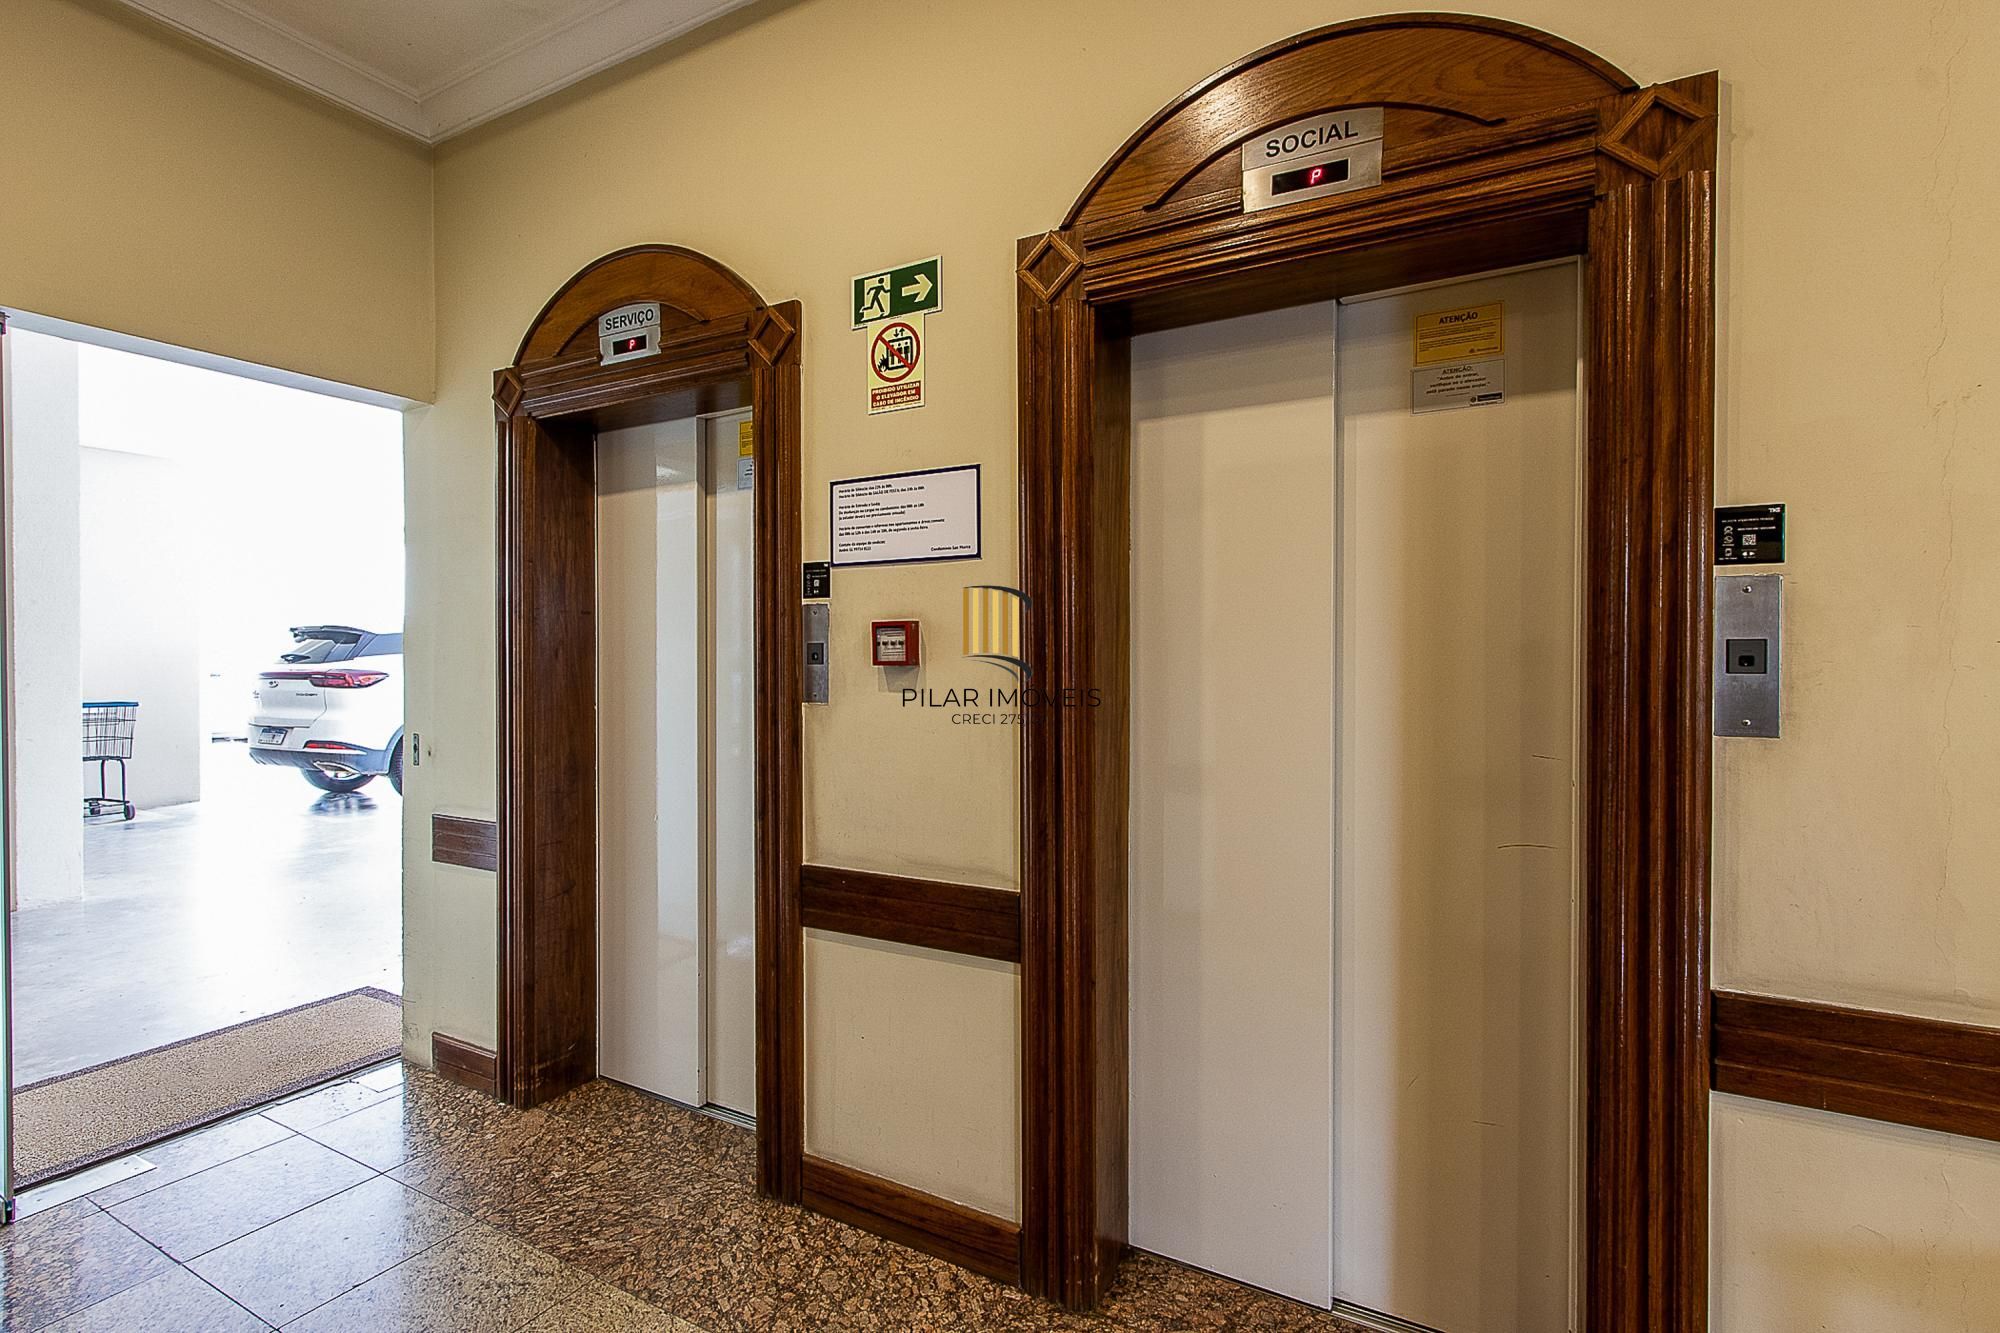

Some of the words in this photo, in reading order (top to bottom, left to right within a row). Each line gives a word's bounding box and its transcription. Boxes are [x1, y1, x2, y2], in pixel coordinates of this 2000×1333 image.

[1265, 120, 1359, 158] SOCIAL
[1310, 168, 1321, 184] P
[605, 308, 654, 330] SERVIÇO
[1439, 312, 1478, 324] ATENÇÃO
[629, 339, 636, 350] P
[872, 386, 895, 394] PROIBIDO
[896, 382, 920, 390] UTILIZAR
[881, 391, 907, 399] ELEVADOR
[895, 395, 919, 403] INCÊNDIO
